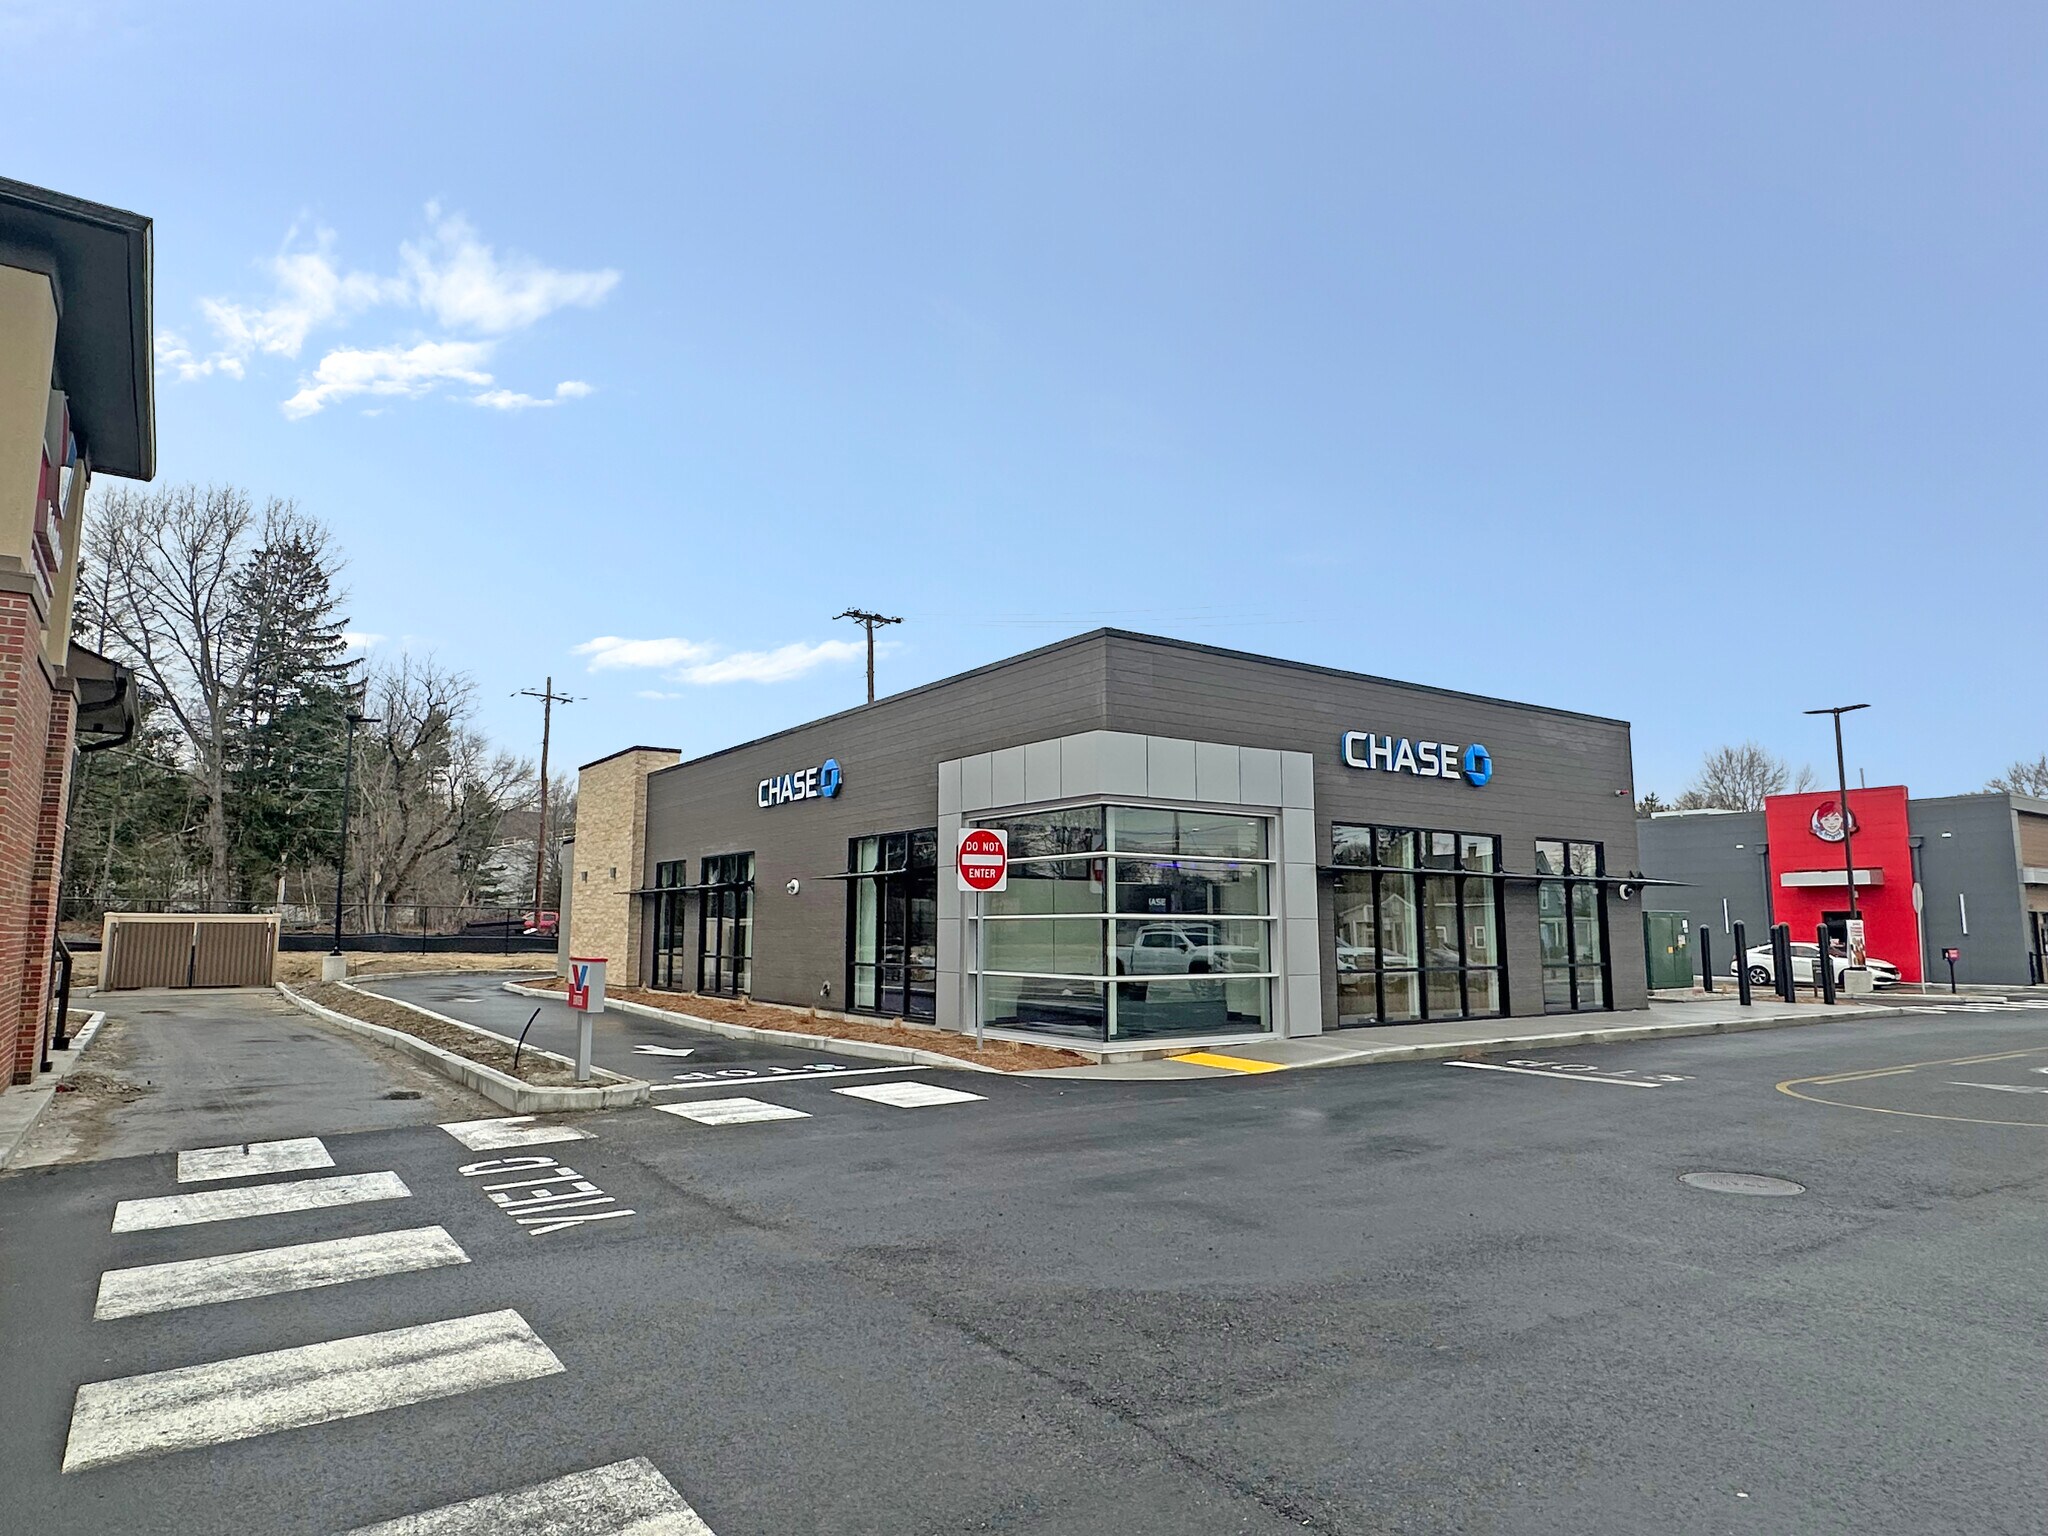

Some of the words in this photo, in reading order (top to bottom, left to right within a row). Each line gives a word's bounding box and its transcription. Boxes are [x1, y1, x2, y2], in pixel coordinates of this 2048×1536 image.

[1341, 730, 1461, 780] CHASE
[758, 767, 818, 808] CHASE
[966, 841, 979, 852] DO
[982, 842, 1000, 852] NOT
[968, 868, 996, 878] ENTER
[673, 1063, 847, 1081] STOP
[457, 1156, 637, 1236] YIELD
